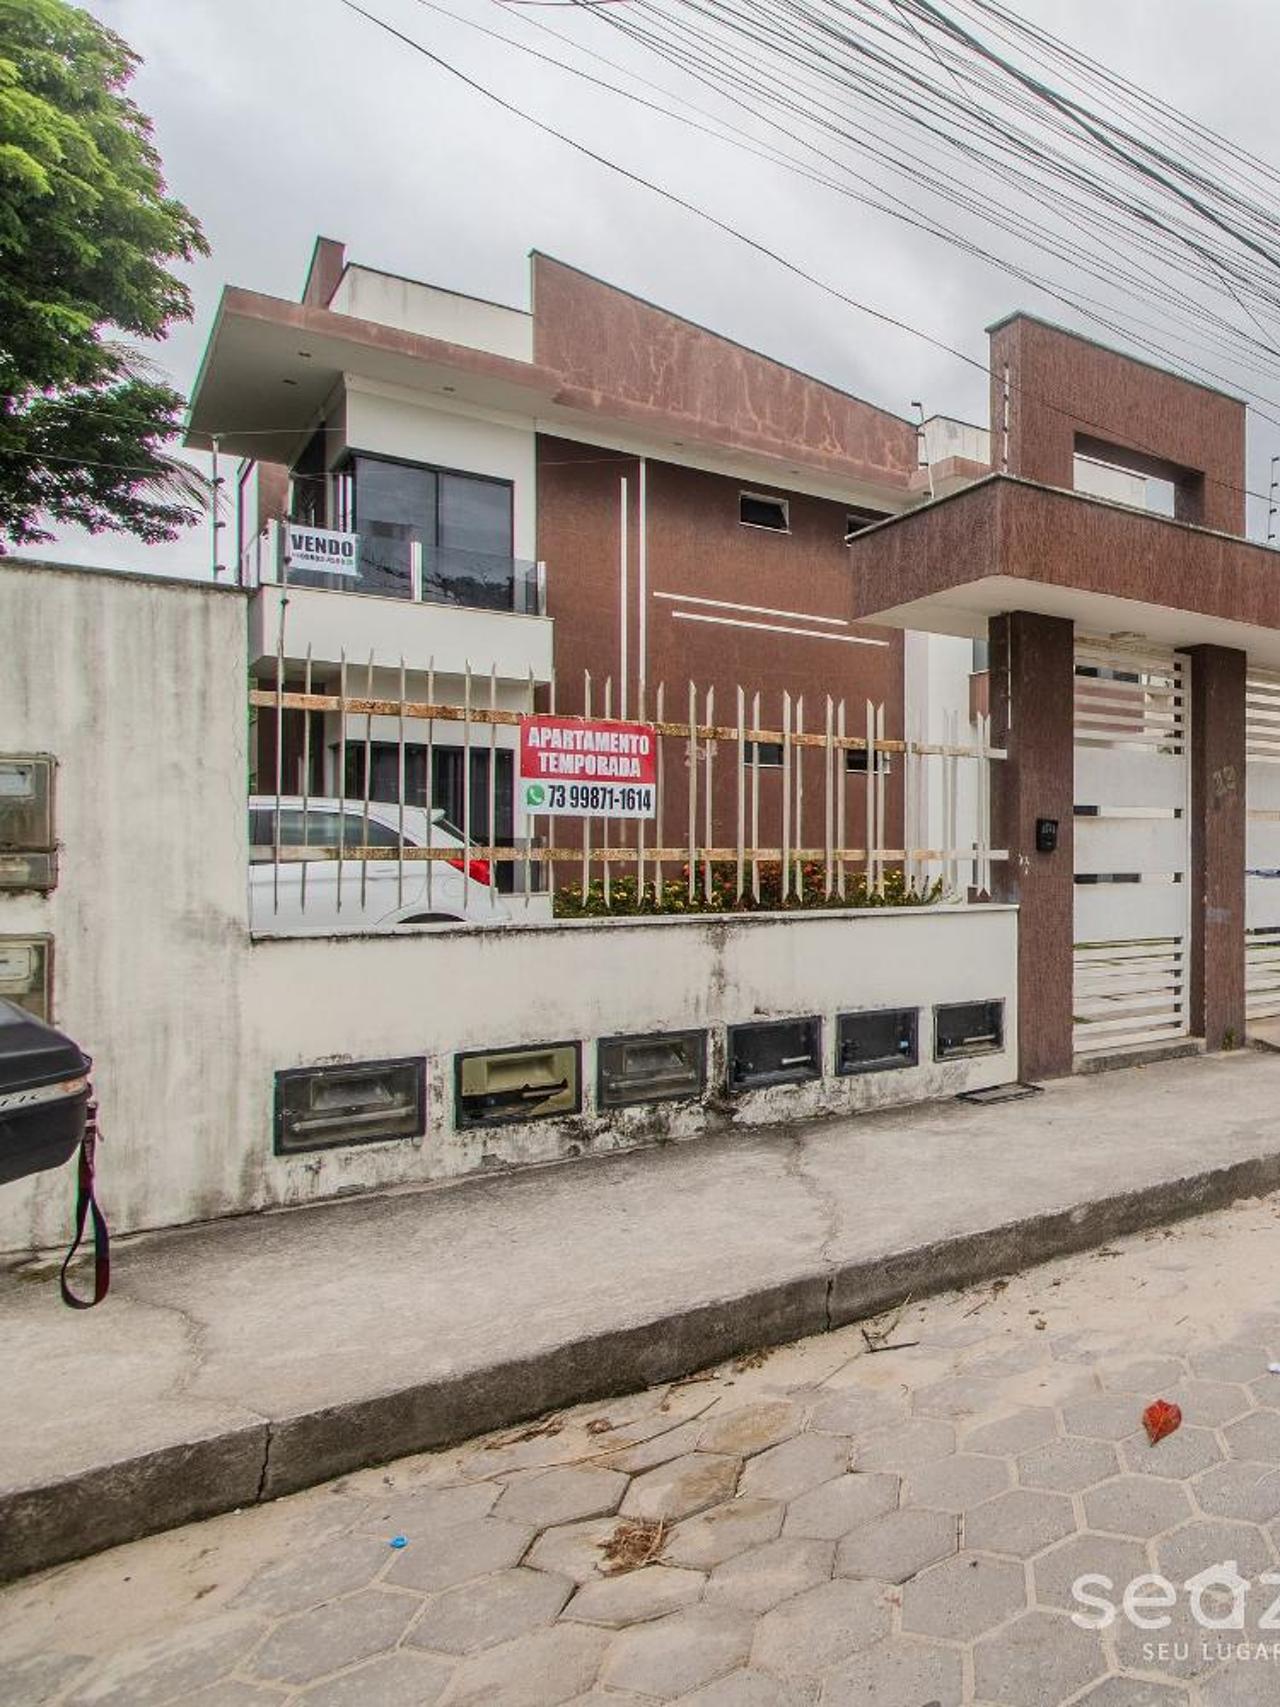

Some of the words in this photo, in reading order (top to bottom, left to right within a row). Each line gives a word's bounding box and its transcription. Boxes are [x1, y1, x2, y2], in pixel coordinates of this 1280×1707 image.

[291, 534, 354, 557] VENDO
[528, 727, 650, 755] APARTAMENTO
[538, 752, 641, 777] TEMPORADA
[548, 785, 566, 808] 73
[570, 785, 651, 811] 99871-1614
